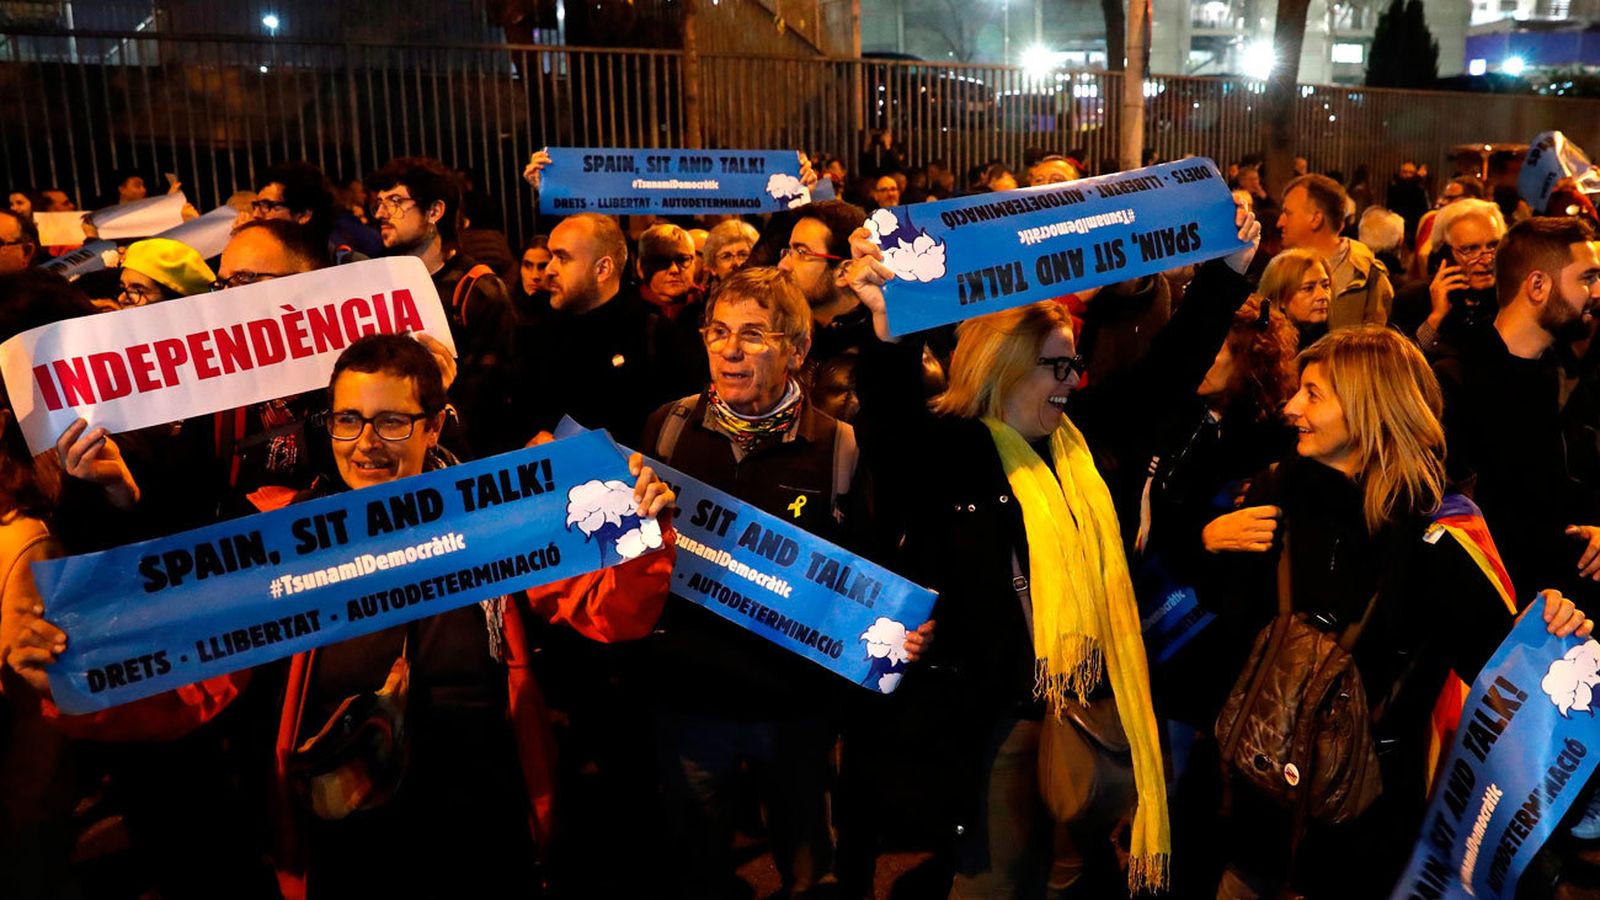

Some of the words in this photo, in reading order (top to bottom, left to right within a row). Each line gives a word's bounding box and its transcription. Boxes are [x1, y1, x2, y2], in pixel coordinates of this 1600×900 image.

[582, 154, 640, 174] SPAIN,
[645, 156, 671, 173] SIT
[678, 156, 713, 173] AND
[719, 156, 765, 174] TALK!
[1177, 166, 1213, 185] DRETS
[553, 197, 586, 209] DRETS
[598, 197, 651, 209] LLIBERTAT
[1099, 176, 1165, 198] LLIBERTAT
[940, 188, 1087, 229] AUTODETERMINACIÓ
[1095, 243, 1127, 275] SIT
[1131, 222, 1201, 263] SPAIN,
[957, 263, 1029, 306] TALK!
[1036, 253, 1084, 286] AND
[32, 288, 425, 412] INDEPENDÈNCIA
[139, 538, 281, 593] SPAIN,
[294, 511, 349, 557] SIT
[367, 487, 445, 538] AND
[455, 458, 555, 513] TALK!
[691, 498, 738, 538] SIT
[738, 521, 800, 568] AND
[804, 552, 882, 609] TALK!
[87, 650, 171, 695] DRETS
[195, 609, 322, 665] LLIBERTAT
[347, 541, 562, 621] AUTODETERMINACIÓ
[687, 572, 845, 660] AUTODETERMINACIÓ
[1442, 757, 1476, 824] AND
[1462, 675, 1529, 764] TALK!
